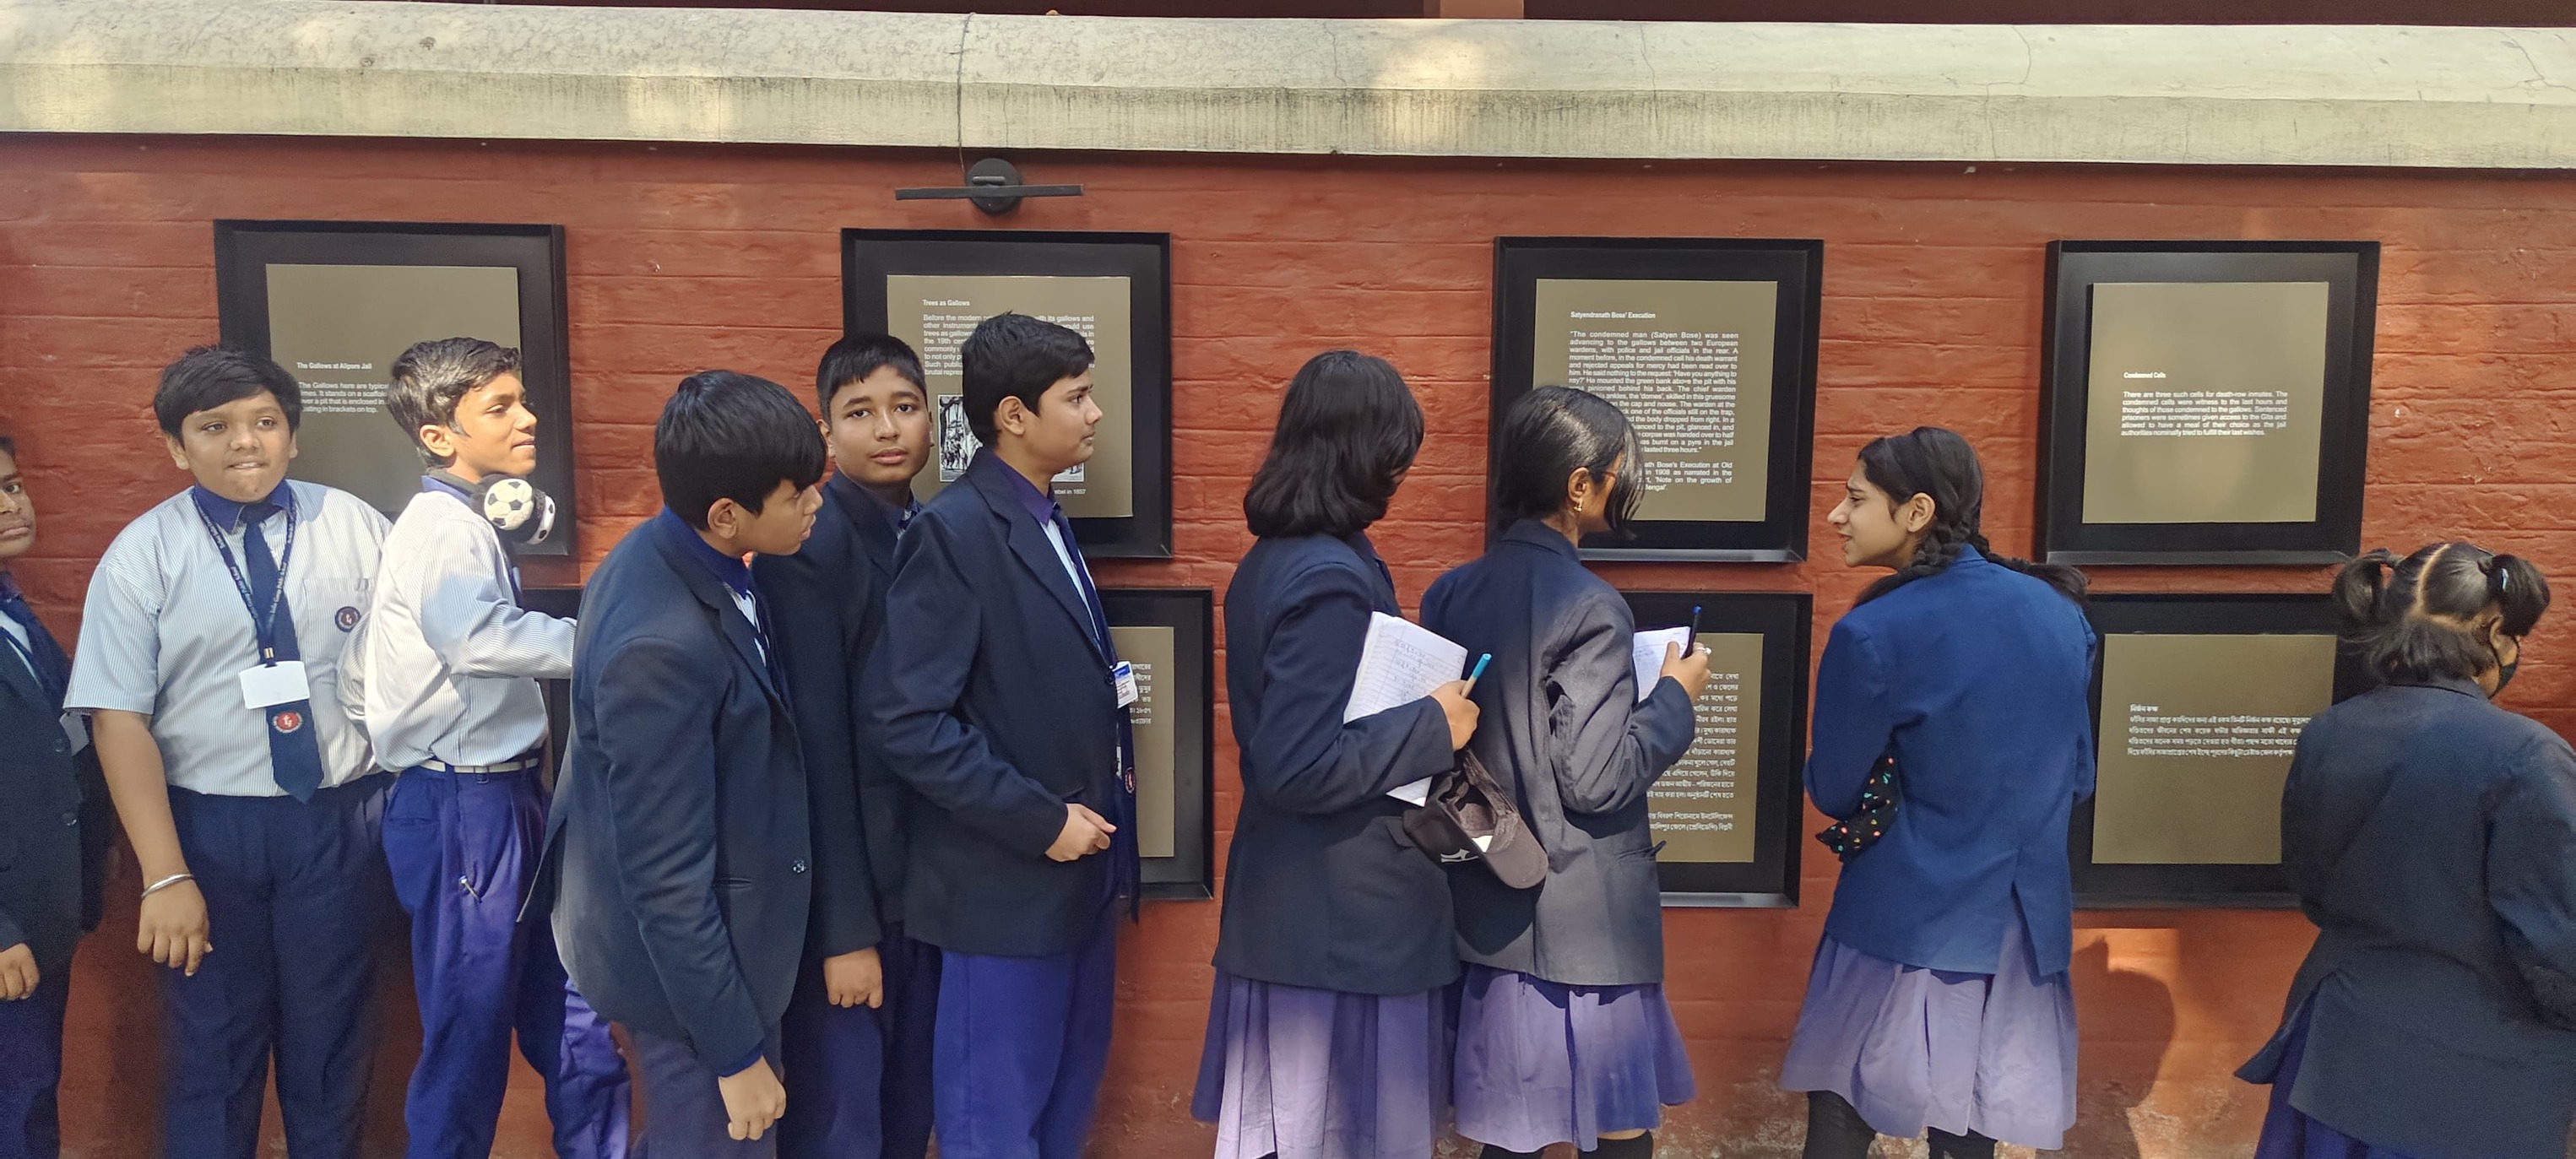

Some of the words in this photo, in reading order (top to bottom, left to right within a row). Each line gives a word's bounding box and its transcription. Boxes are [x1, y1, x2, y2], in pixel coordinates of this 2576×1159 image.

[1681, 332, 1701, 340] Bose)
[1570, 338, 1603, 347] advancing
[1630, 339, 1657, 348] gallows
[1706, 339, 1738, 348] European
[1617, 347, 1635, 355] police
[1654, 347, 1663, 355] jail
[1582, 362, 1608, 371] rejected
[1609, 362, 1634, 371] appeals
[1588, 385, 1615, 393] pinioned
[1700, 477, 1722, 485] growth
